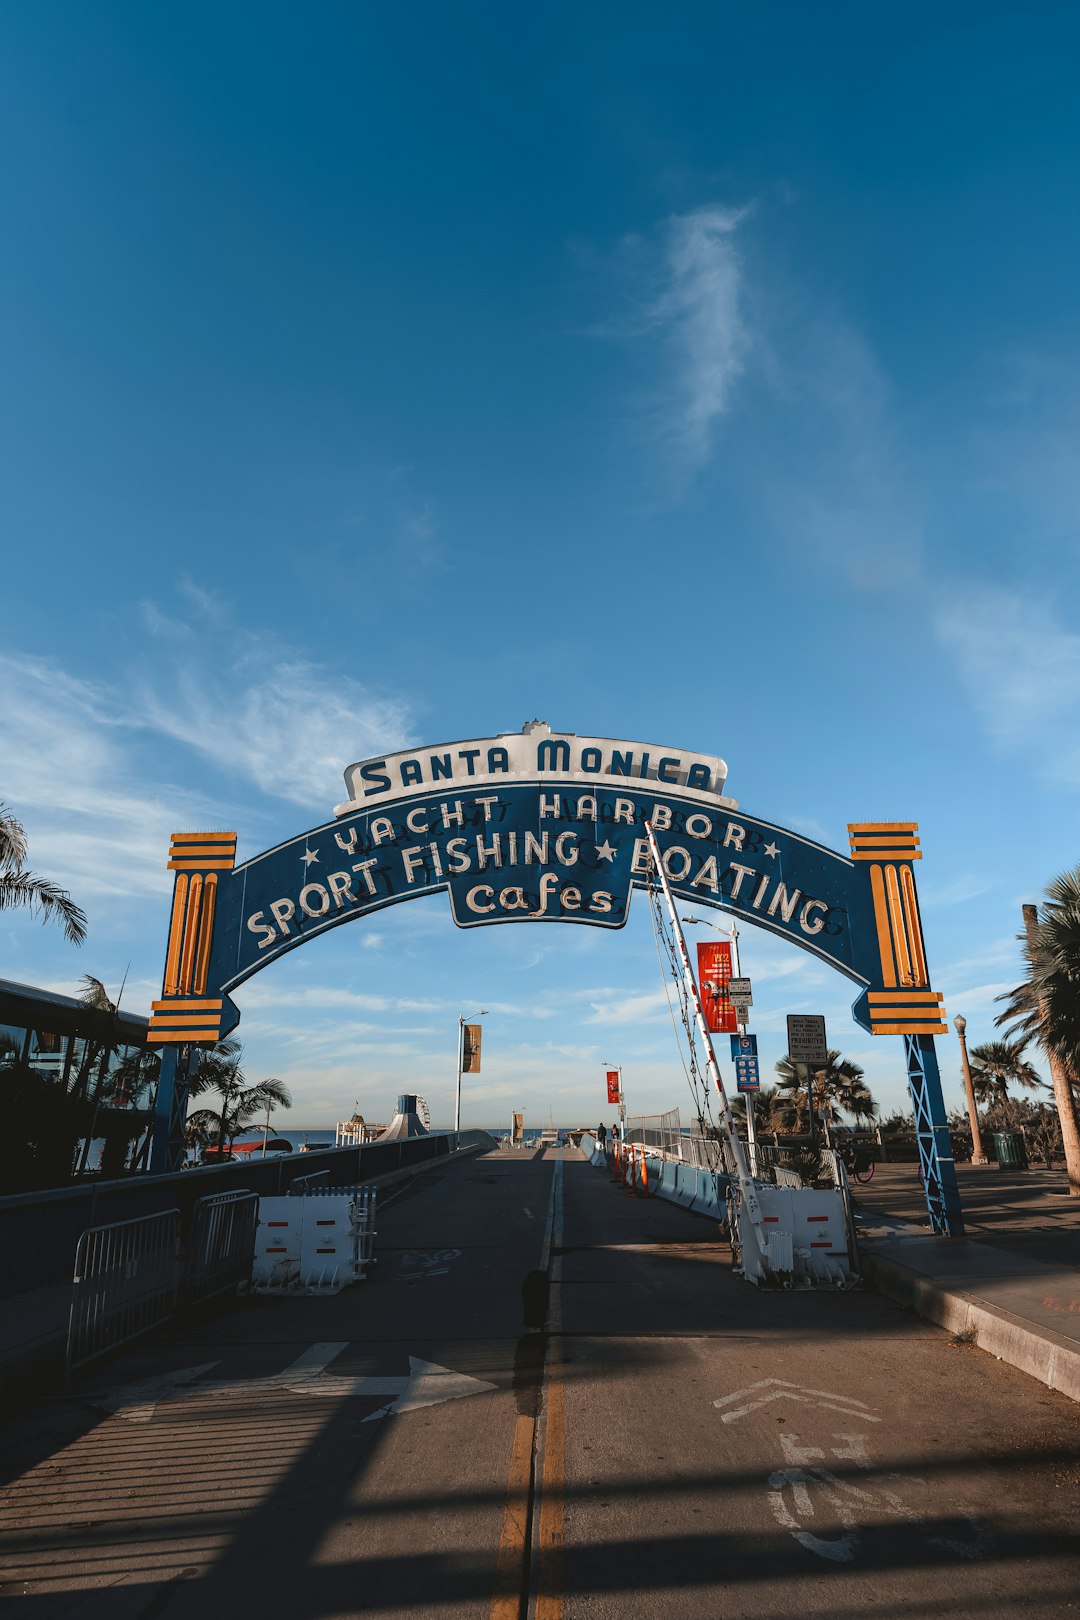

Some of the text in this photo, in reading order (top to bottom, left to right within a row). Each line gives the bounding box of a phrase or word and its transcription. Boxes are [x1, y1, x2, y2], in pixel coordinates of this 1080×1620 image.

[360, 739, 711, 795] SANTA MONICA
[334, 793, 746, 855] YACHT HARBOR
[246, 830, 829, 949] SPORT FISHING BOATING
[465, 872, 613, 917] cafes
